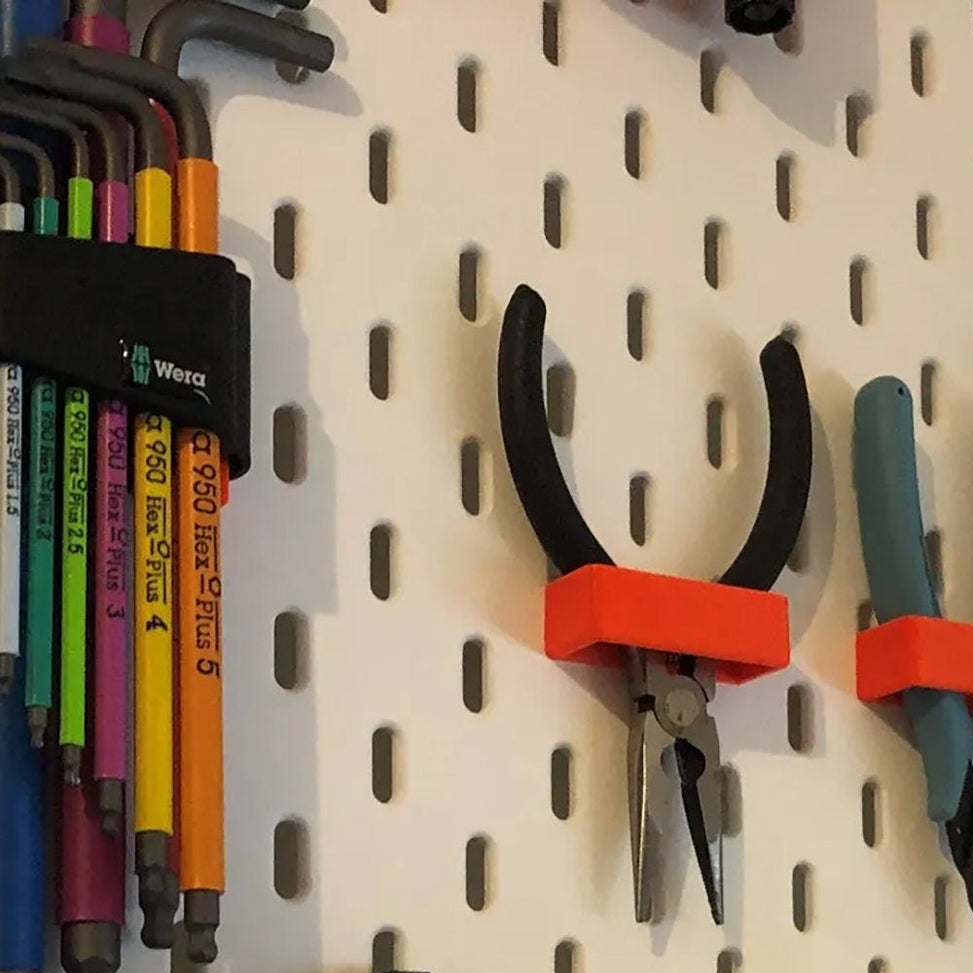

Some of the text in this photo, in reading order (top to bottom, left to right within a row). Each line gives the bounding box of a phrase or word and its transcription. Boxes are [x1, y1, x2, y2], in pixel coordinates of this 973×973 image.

[153, 358, 206, 387] Wera
[6, 386, 20, 414] 950
[71, 410, 86, 441] 950
[109, 426, 126, 470] 950
[145, 440, 168, 484] 950
[193, 463, 217, 514] 950
[67, 528, 83, 554] 2.5
[106, 604, 126, 619] 3
[145, 615, 168, 632] 4
[196, 658, 220, 678] 5
